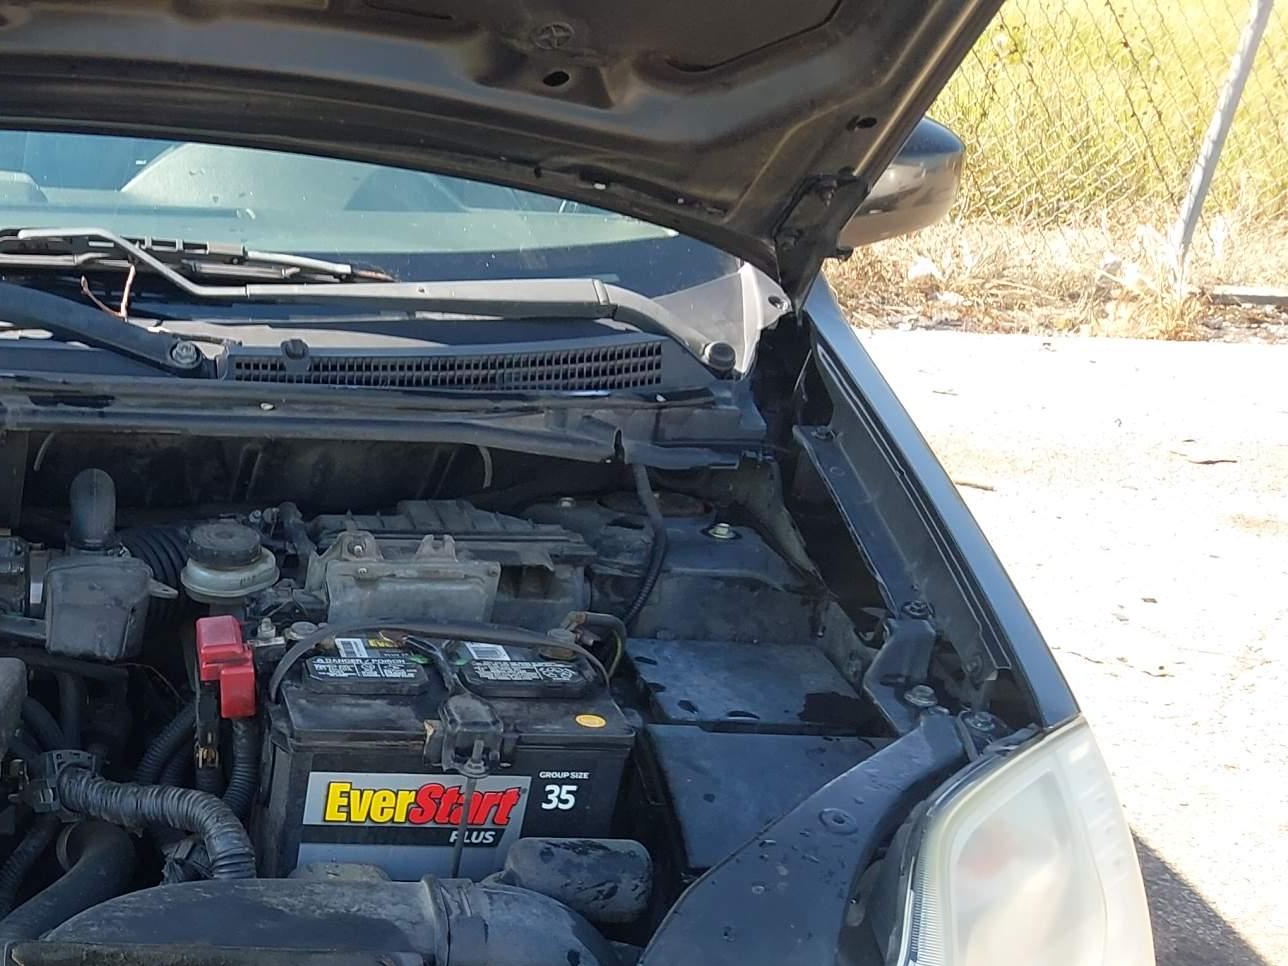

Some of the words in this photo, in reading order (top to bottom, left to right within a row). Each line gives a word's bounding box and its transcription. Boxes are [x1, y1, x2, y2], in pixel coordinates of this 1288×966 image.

[539, 771, 570, 779] GROUP
[324, 781, 520, 825] EverStart
[542, 784, 578, 810] 35
[449, 830, 495, 844] PLUS
